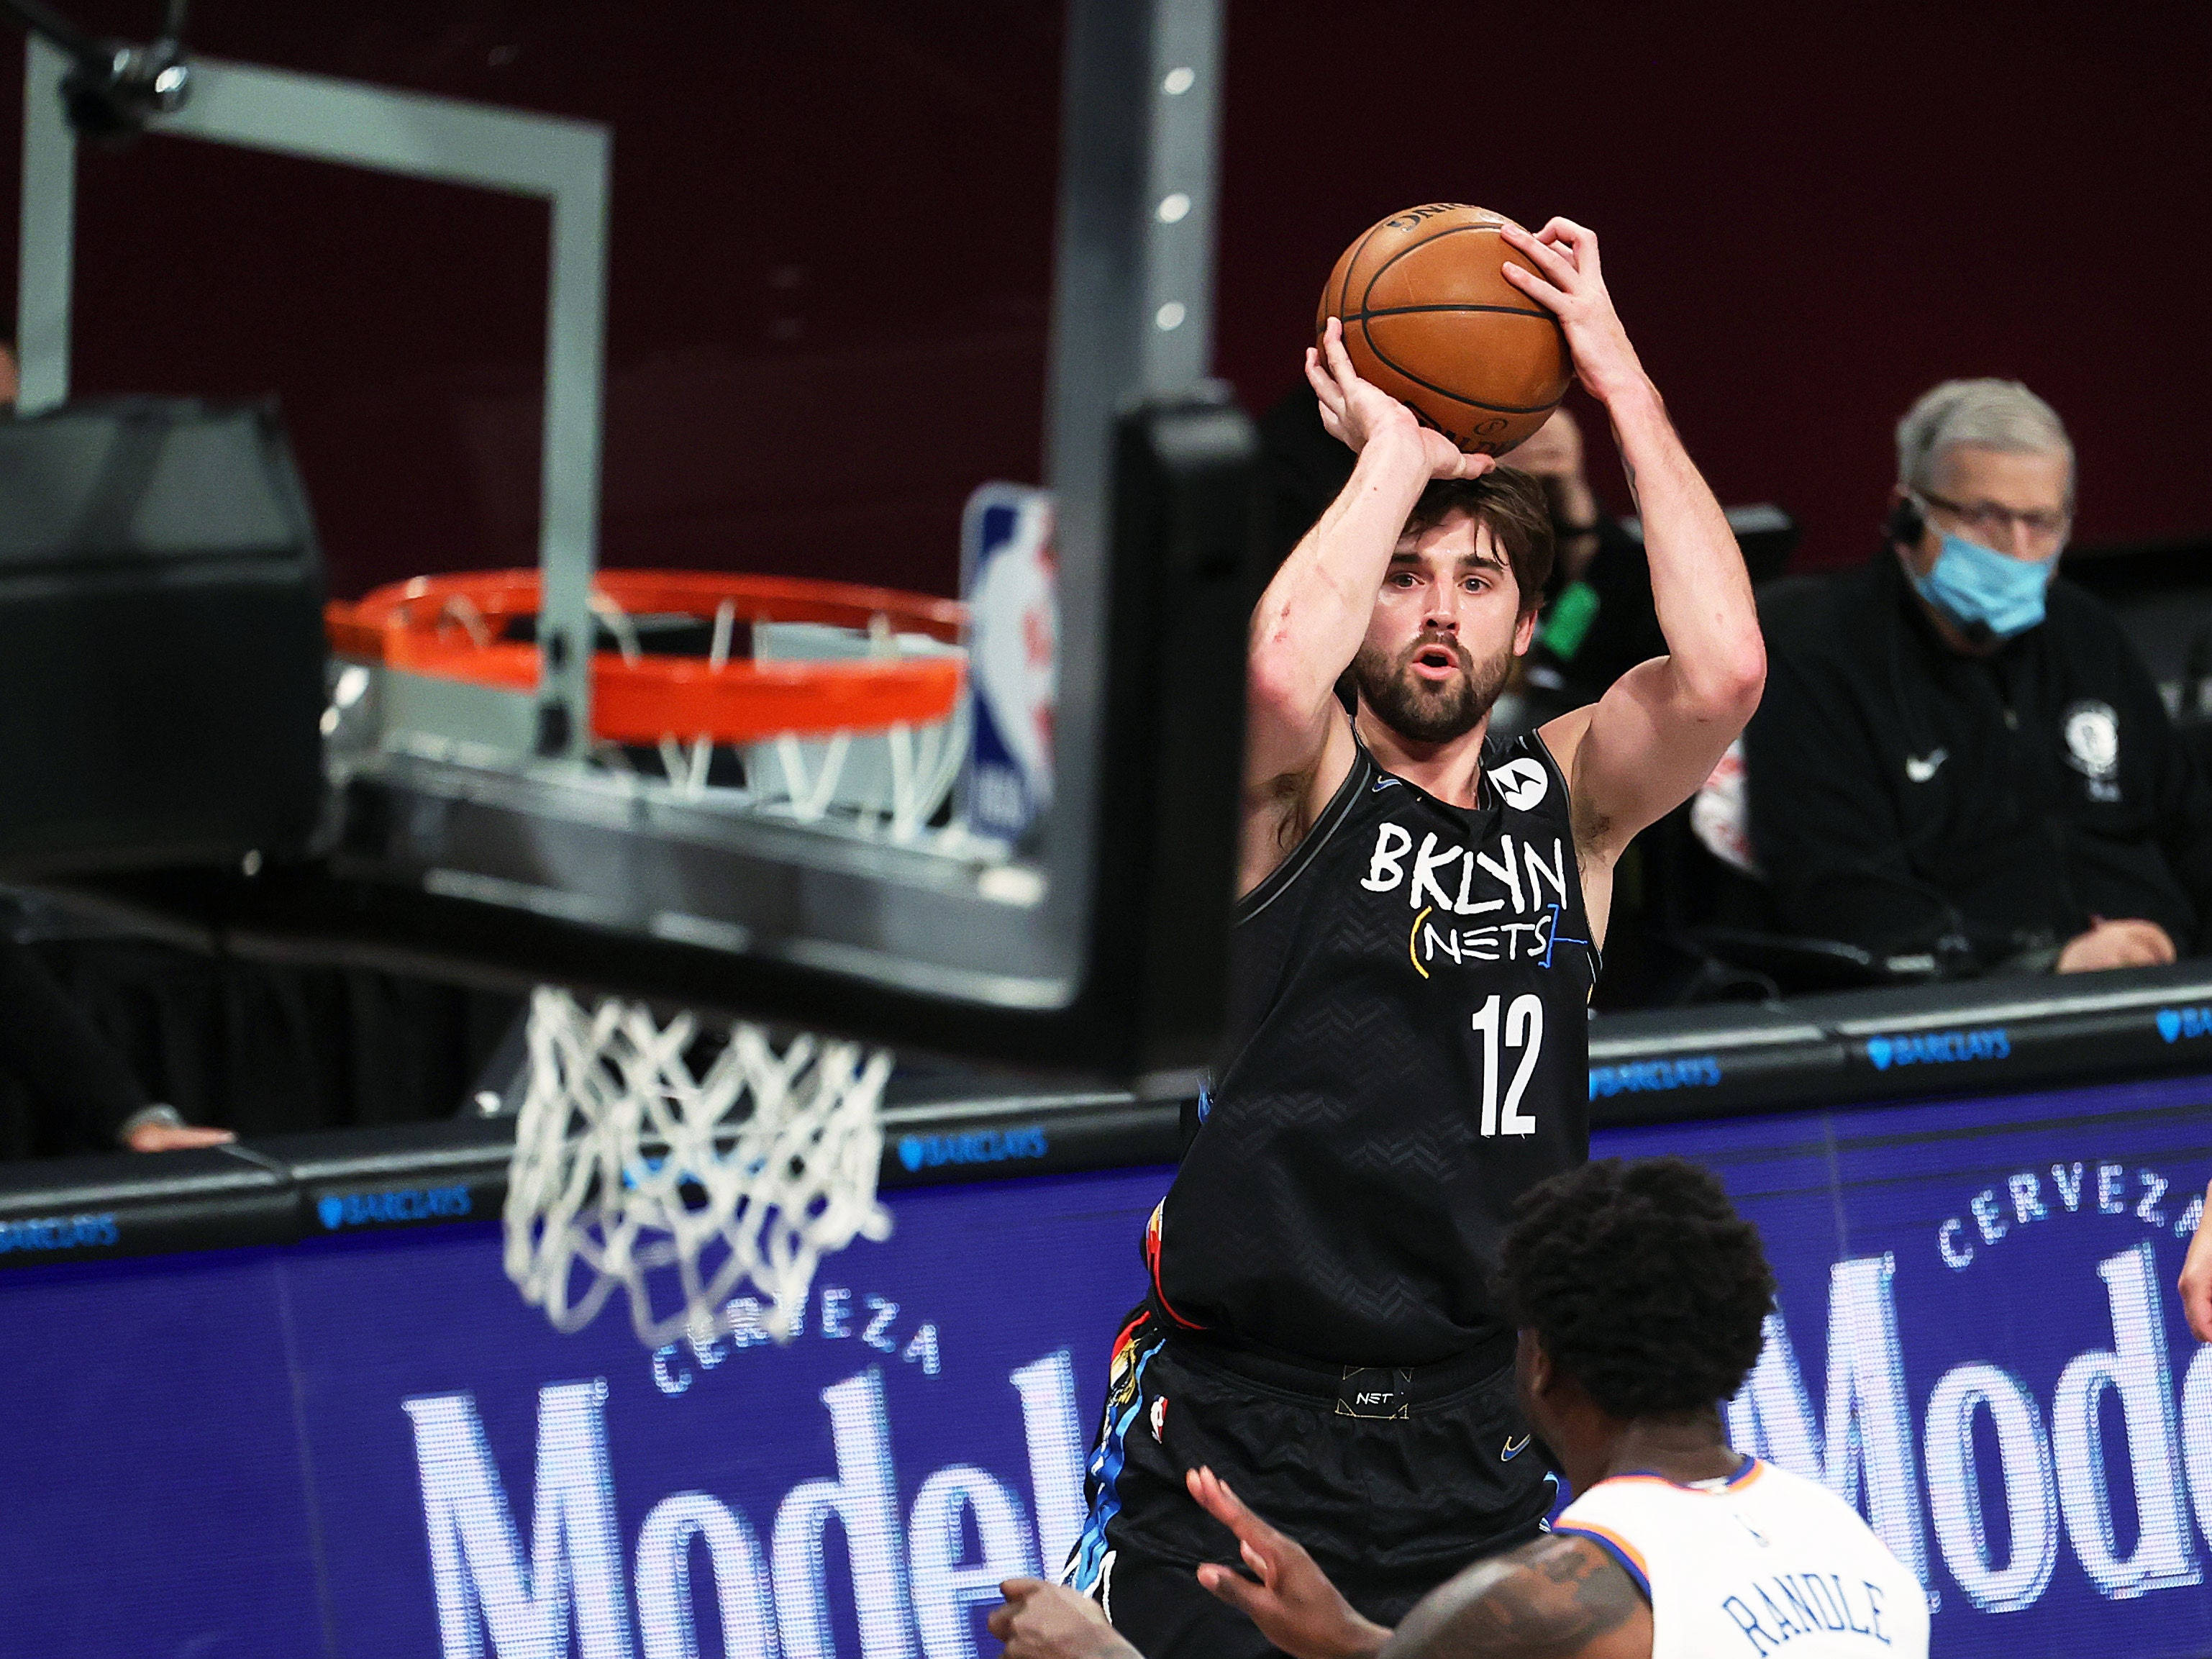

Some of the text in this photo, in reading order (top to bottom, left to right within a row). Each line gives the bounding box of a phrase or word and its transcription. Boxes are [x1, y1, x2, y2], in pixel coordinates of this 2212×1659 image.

[1360, 822, 1567, 915] BKLYN
[1472, 993, 1544, 1137] 12
[1595, 1055, 1718, 1097] BARCLAYS
[1893, 1029, 2011, 1065] BARCLAYS
[1355, 1391, 1404, 1405] NET
[1721, 1573, 1891, 1658] RANDLE
